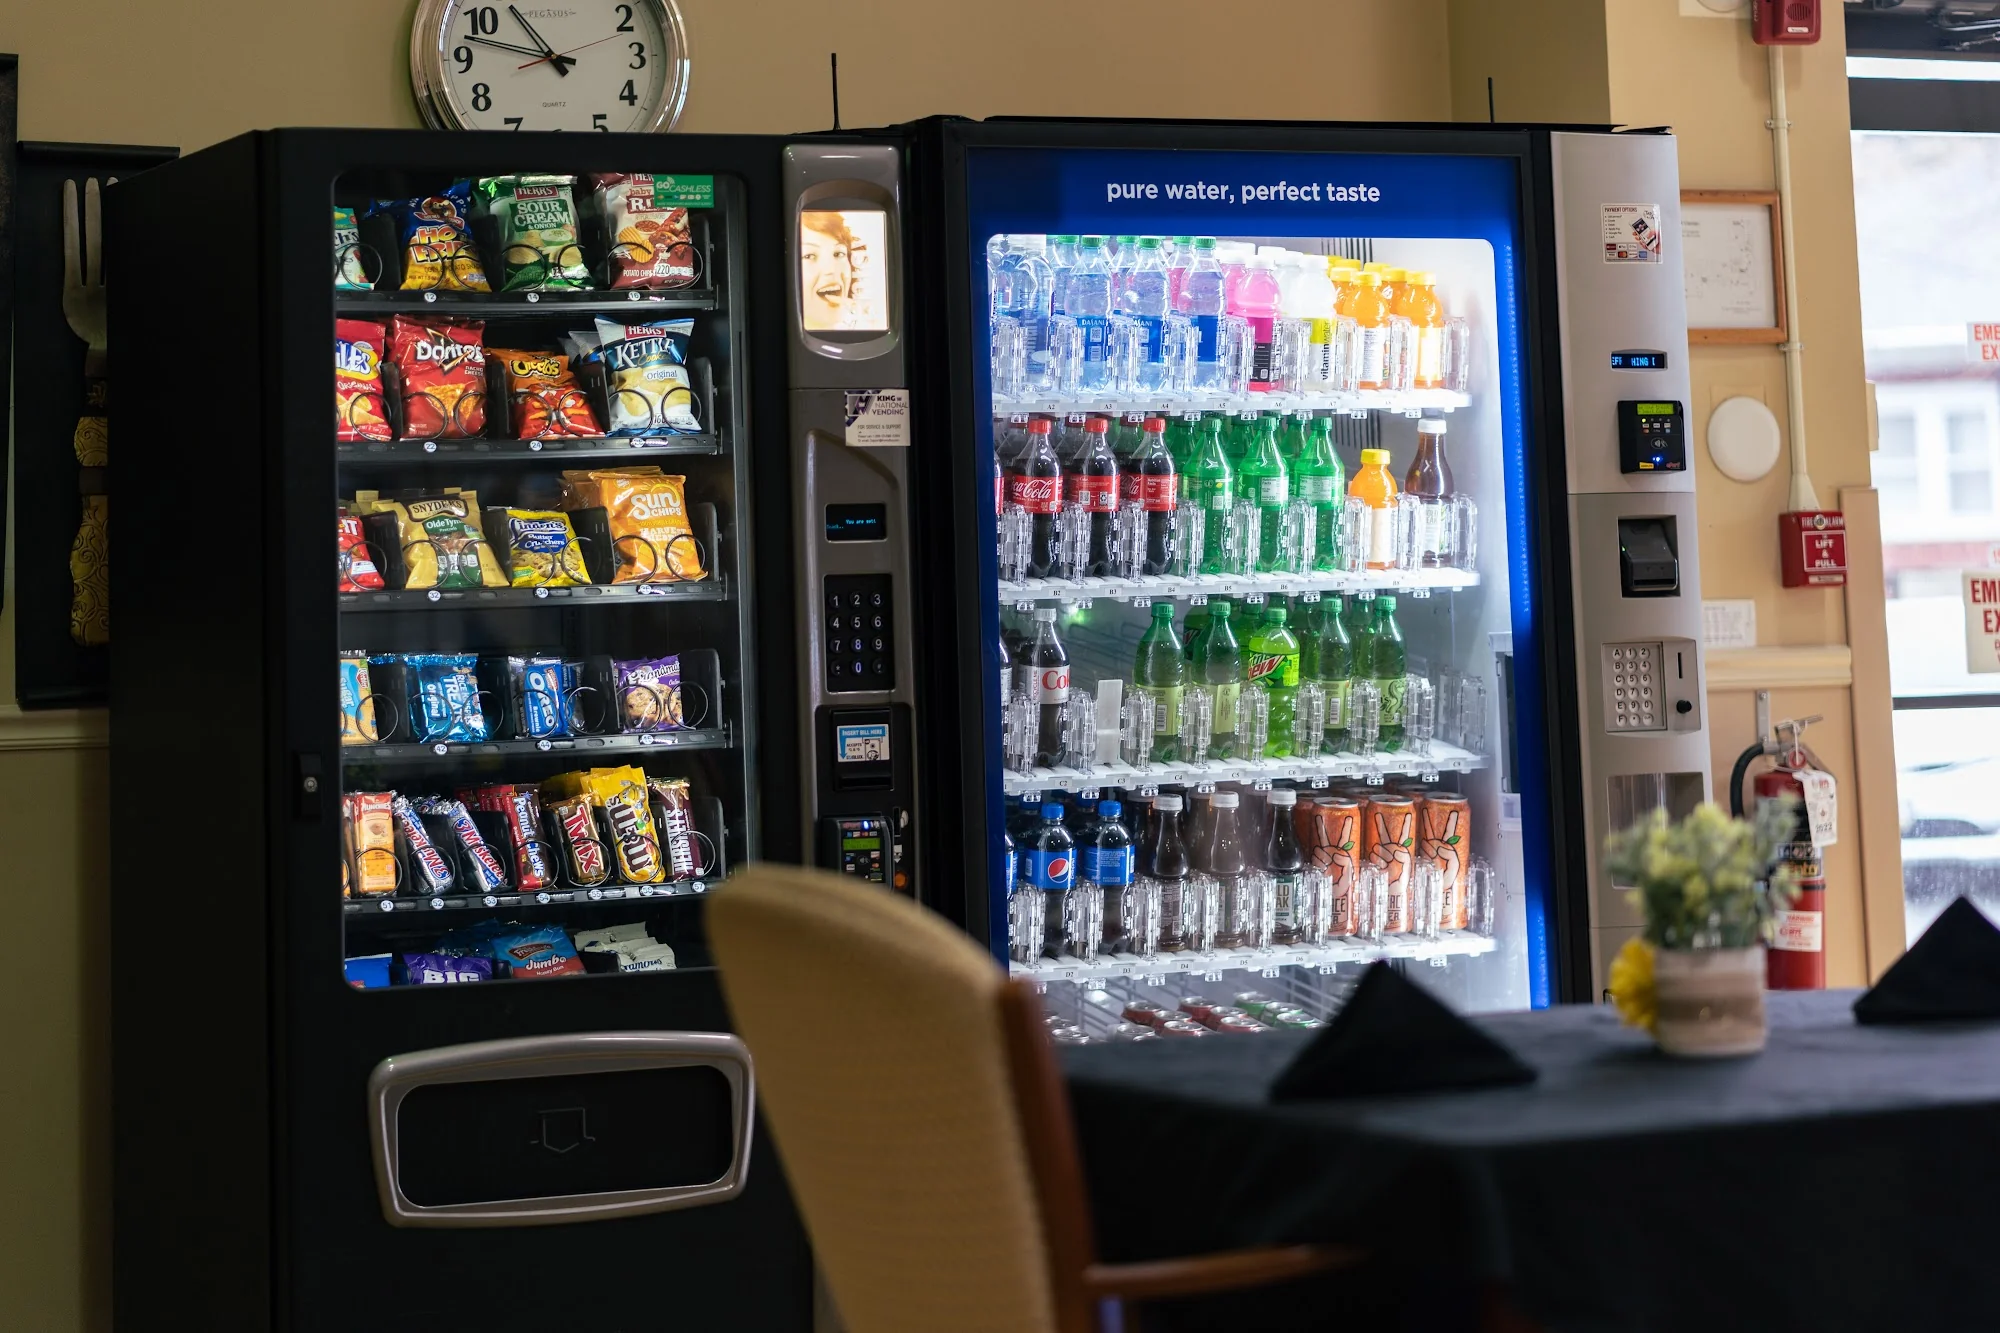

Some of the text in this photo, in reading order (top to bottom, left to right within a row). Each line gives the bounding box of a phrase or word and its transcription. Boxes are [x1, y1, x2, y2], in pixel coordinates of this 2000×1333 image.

[528, 9, 569, 18] PEGASUS
[615, 4, 635, 33] 2
[464, 6, 499, 36] 10
[453, 45, 474, 74] 9
[628, 42, 647, 70] 3
[471, 82, 492, 112] 8
[619, 79, 638, 107] 4
[592, 113, 609, 133] 5
[629, 188, 652, 196] baby
[656, 181, 712, 193] GO CASHLESS
[1107, 180, 1381, 204] pure water, perfect taste
[517, 201, 562, 214] SOUR
[514, 211, 571, 227] CREAM
[534, 222, 557, 230] ONION
[623, 269, 639, 277] POTATO
[656, 265, 670, 275] 220
[1973, 323, 2000, 341] EME
[416, 340, 485, 362] Doritos
[615, 337, 675, 368] KETTLE
[1320, 321, 1330, 381] vitaminwater
[1981, 344, 2000, 361] EX
[646, 369, 678, 379] Original
[1012, 479, 1054, 498] ca-Cola
[631, 492, 680, 520] Sun
[650, 507, 682, 516] CHIPS
[426, 518, 463, 529] Olde Tym
[1802, 516, 1844, 528] FIRE ALARM
[524, 539, 565, 549] Cruchers
[1815, 539, 1834, 549] LIFT
[1822, 549, 1829, 558] &
[1815, 559, 1837, 568] PULL
[1971, 578, 2000, 603] EM
[834, 596, 839, 606] 1
[854, 595, 860, 605] 2
[874, 594, 881, 604] 3
[833, 618, 839, 628] 4
[854, 617, 860, 628] 5
[874, 616, 881, 627] 6
[834, 640, 840, 651] 7
[855, 639, 861, 650] 8
[875, 638, 882, 649] 9
[855, 662, 861, 673] 0
[1041, 669, 1070, 691] Co
[427, 684, 440, 717] Original
[529, 672, 555, 727] OREO
[533, 706, 541, 733] Brownie
[453, 817, 472, 832] 3
[513, 797, 535, 839] Peanut
[526, 840, 545, 878] Chews
[564, 804, 599, 874] TWIX
[526, 955, 567, 971] Jumbo
[553, 965, 564, 973] Bun
[621, 958, 662, 971] amous
[423, 969, 480, 984] BIG
